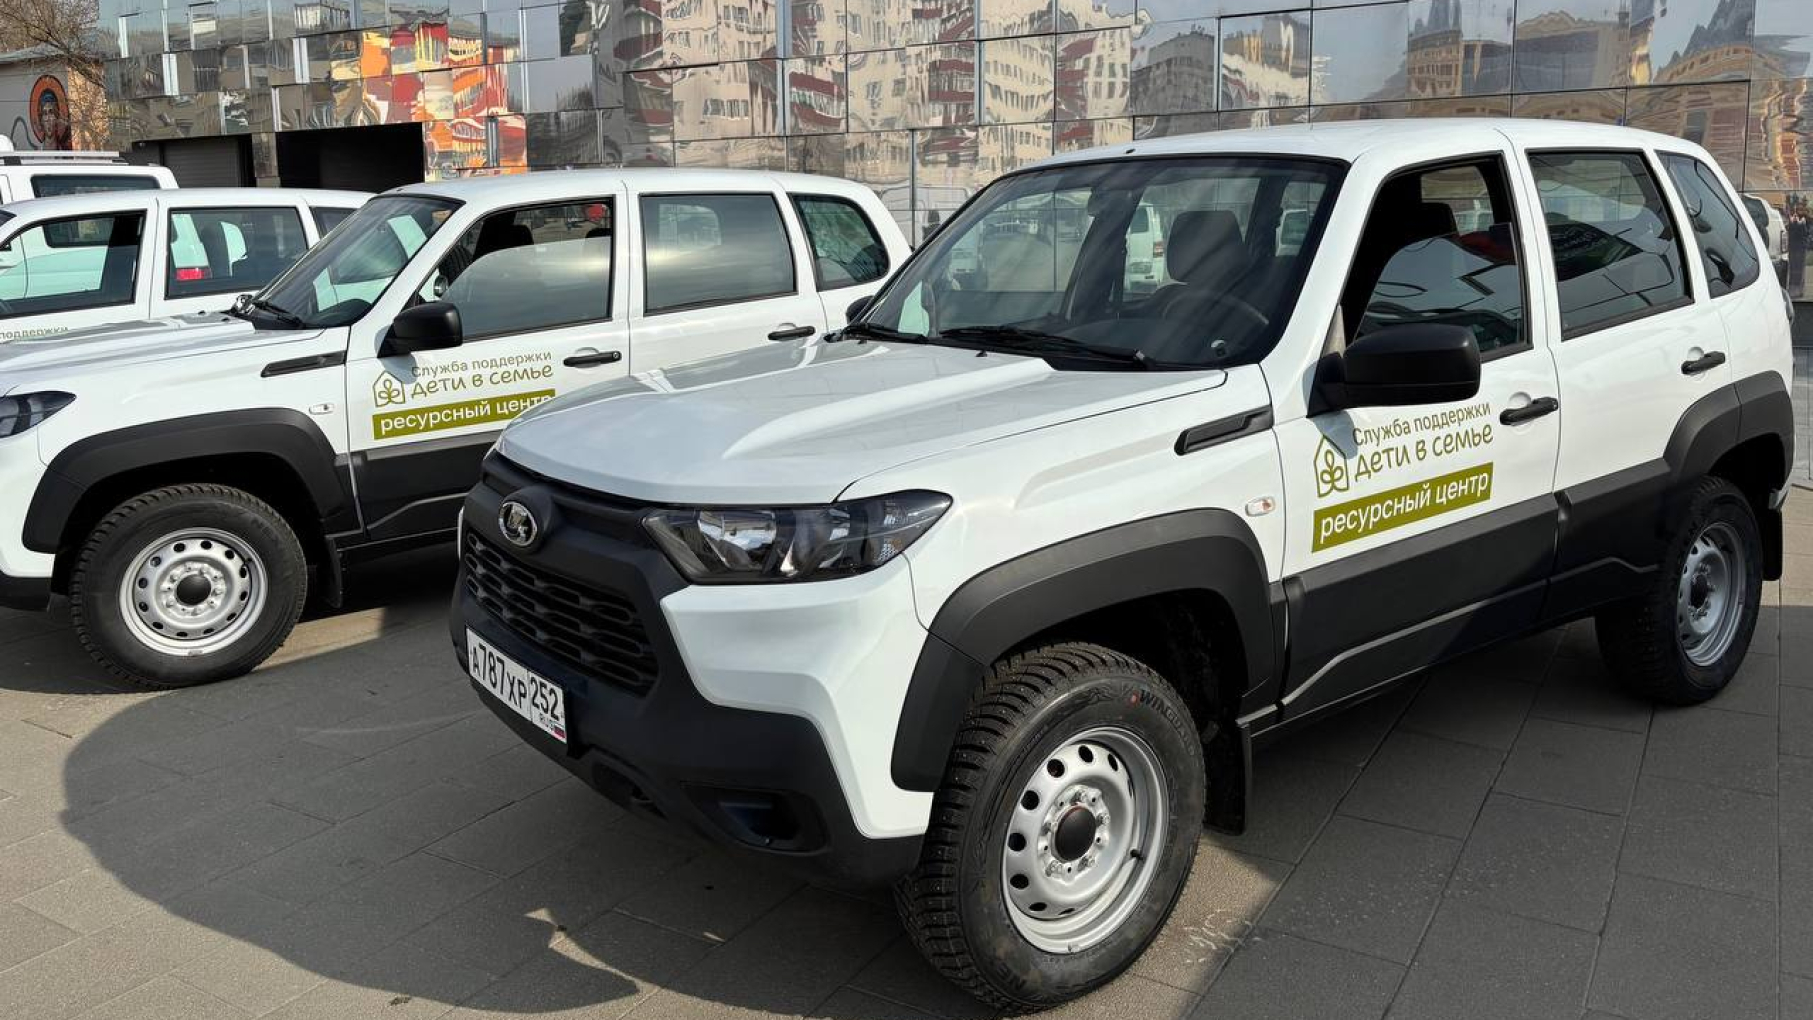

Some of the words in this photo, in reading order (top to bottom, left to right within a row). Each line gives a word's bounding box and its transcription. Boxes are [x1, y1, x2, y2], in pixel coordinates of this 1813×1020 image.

[411, 362, 468, 378] Служба
[472, 351, 552, 370] поддержки
[472, 374, 484, 388] в
[489, 365, 554, 386] семье
[380, 403, 491, 434] ресурсный
[1353, 420, 1411, 446] Служба
[1414, 403, 1492, 430] поддержки
[1415, 439, 1427, 462] в
[1432, 424, 1494, 457] семье
[1320, 484, 1432, 543] ресурсный
[1435, 472, 1488, 505] центр
